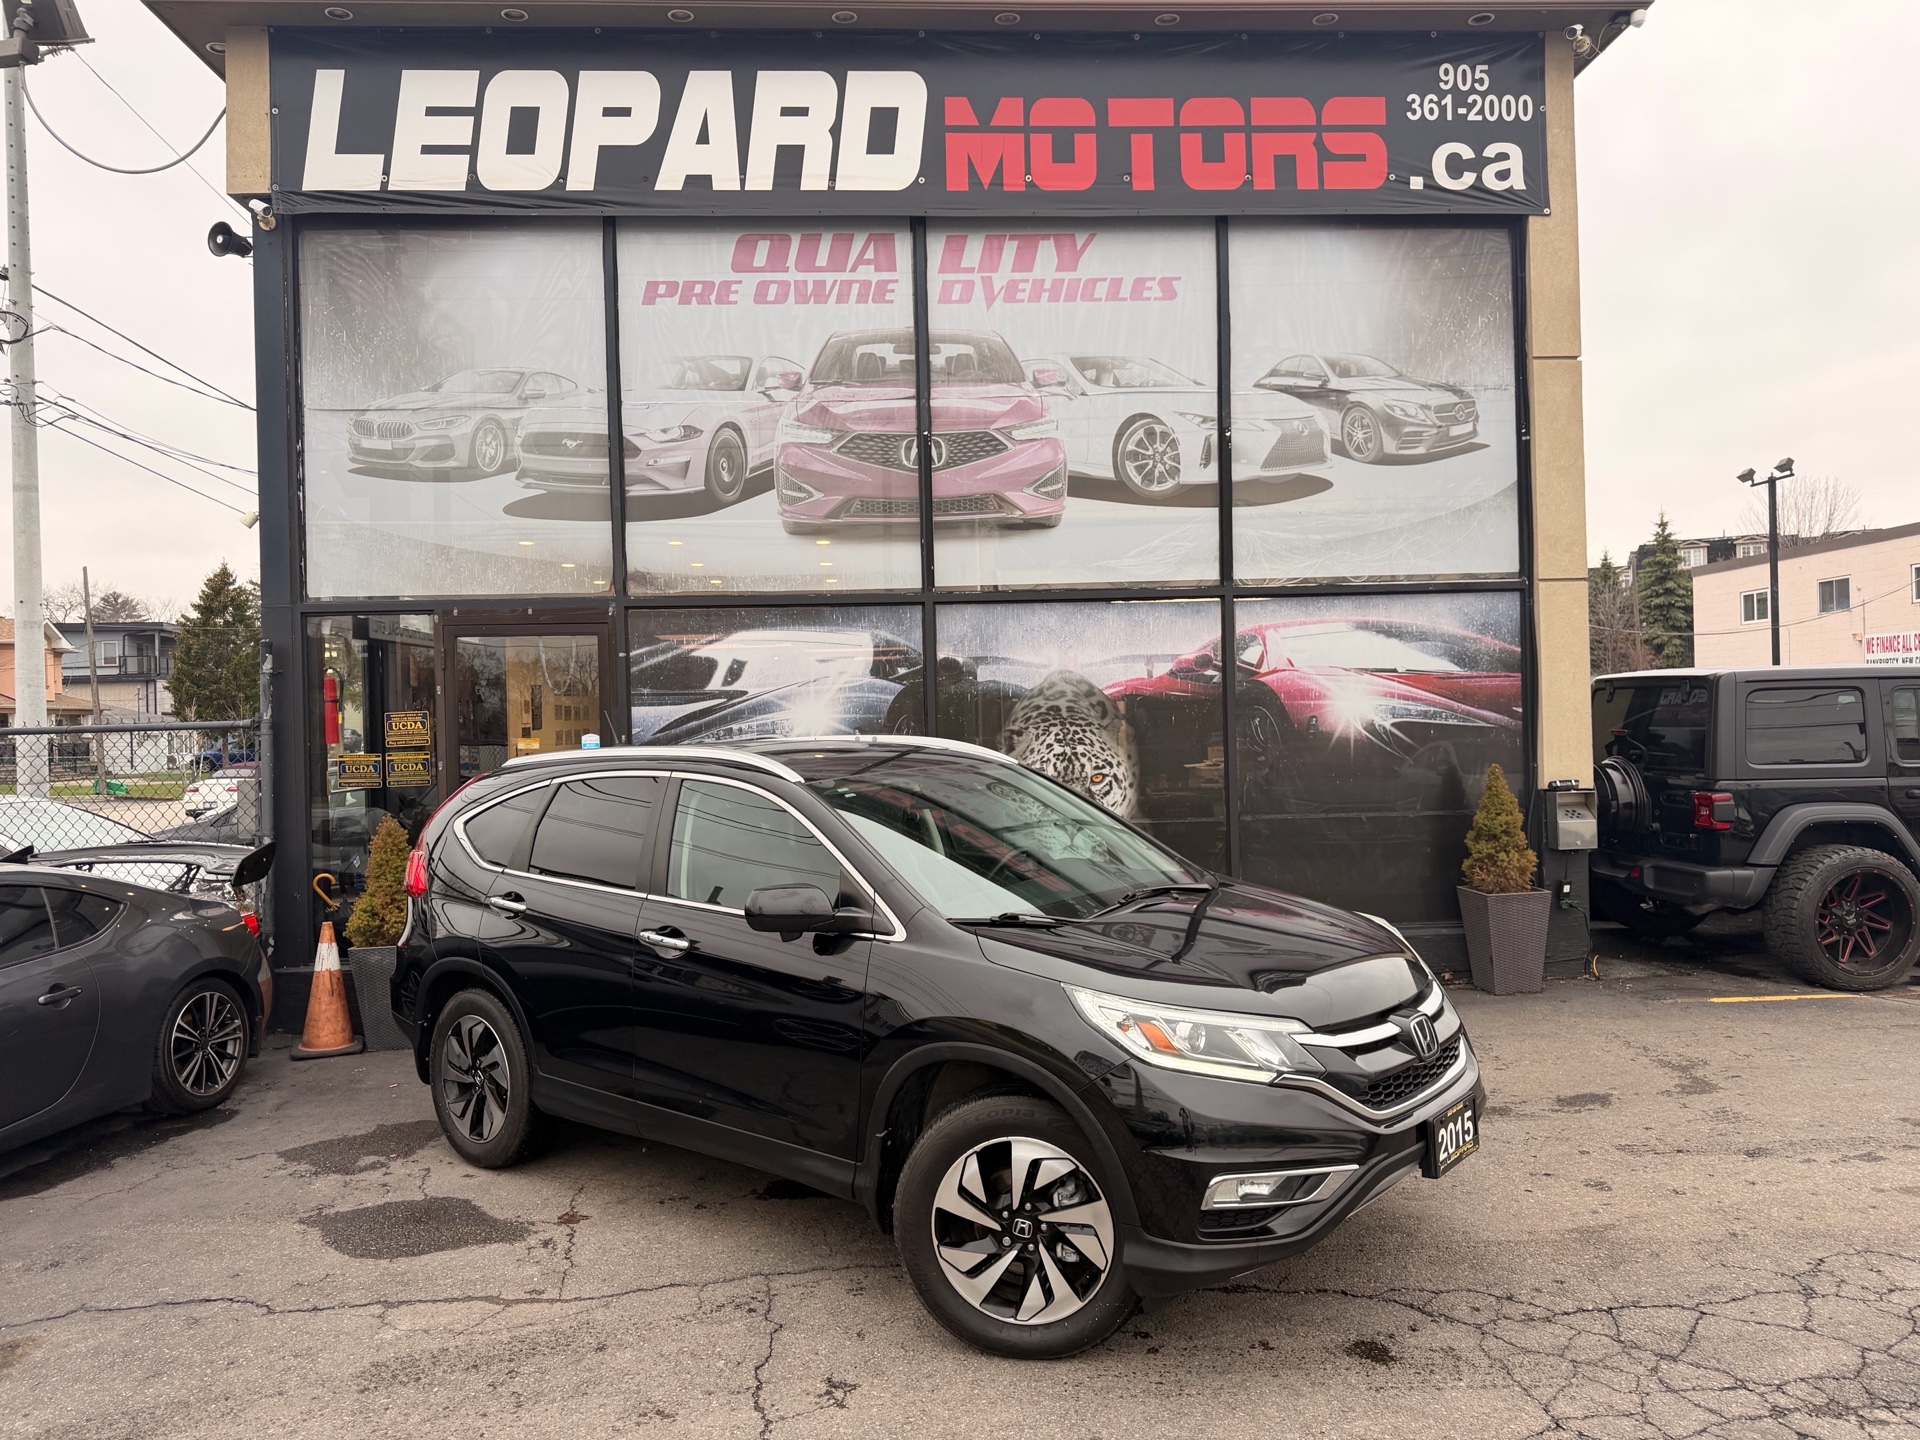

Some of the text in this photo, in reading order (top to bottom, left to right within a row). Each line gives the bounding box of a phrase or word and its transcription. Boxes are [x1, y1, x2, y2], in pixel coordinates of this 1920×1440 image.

[1438, 62, 1490, 91] 905
[1405, 93, 1534, 122] 361-2000
[302, 69, 1388, 192] LEOPARD MOTORS
[1409, 142, 1527, 191] .ca
[641, 279, 743, 306] PRE
[1866, 637, 1875, 654] WE
[1877, 635, 1900, 653] FINANCE
[1902, 634, 1912, 652] ALL
[392, 721, 423, 730] UCDA
[345, 765, 376, 773] UCDA
[394, 763, 424, 771] UCDA
[1438, 1109, 1474, 1162] 2015
